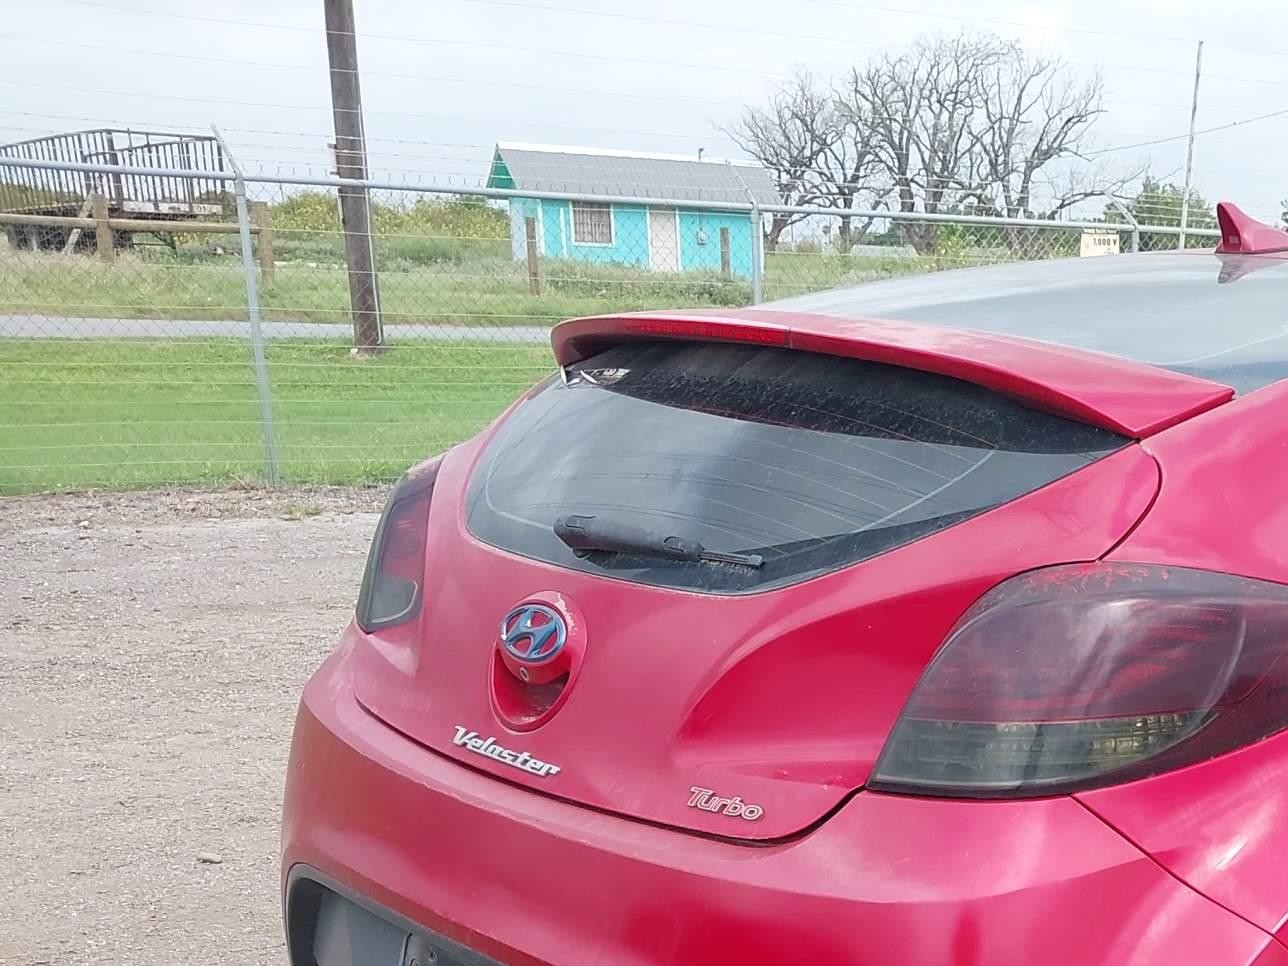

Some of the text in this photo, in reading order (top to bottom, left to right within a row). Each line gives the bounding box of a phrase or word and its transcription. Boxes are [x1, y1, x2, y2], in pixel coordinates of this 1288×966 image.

[1112, 237, 1118, 246] V
[452, 725, 561, 777] Veloster
[687, 786, 764, 820] Turbo
